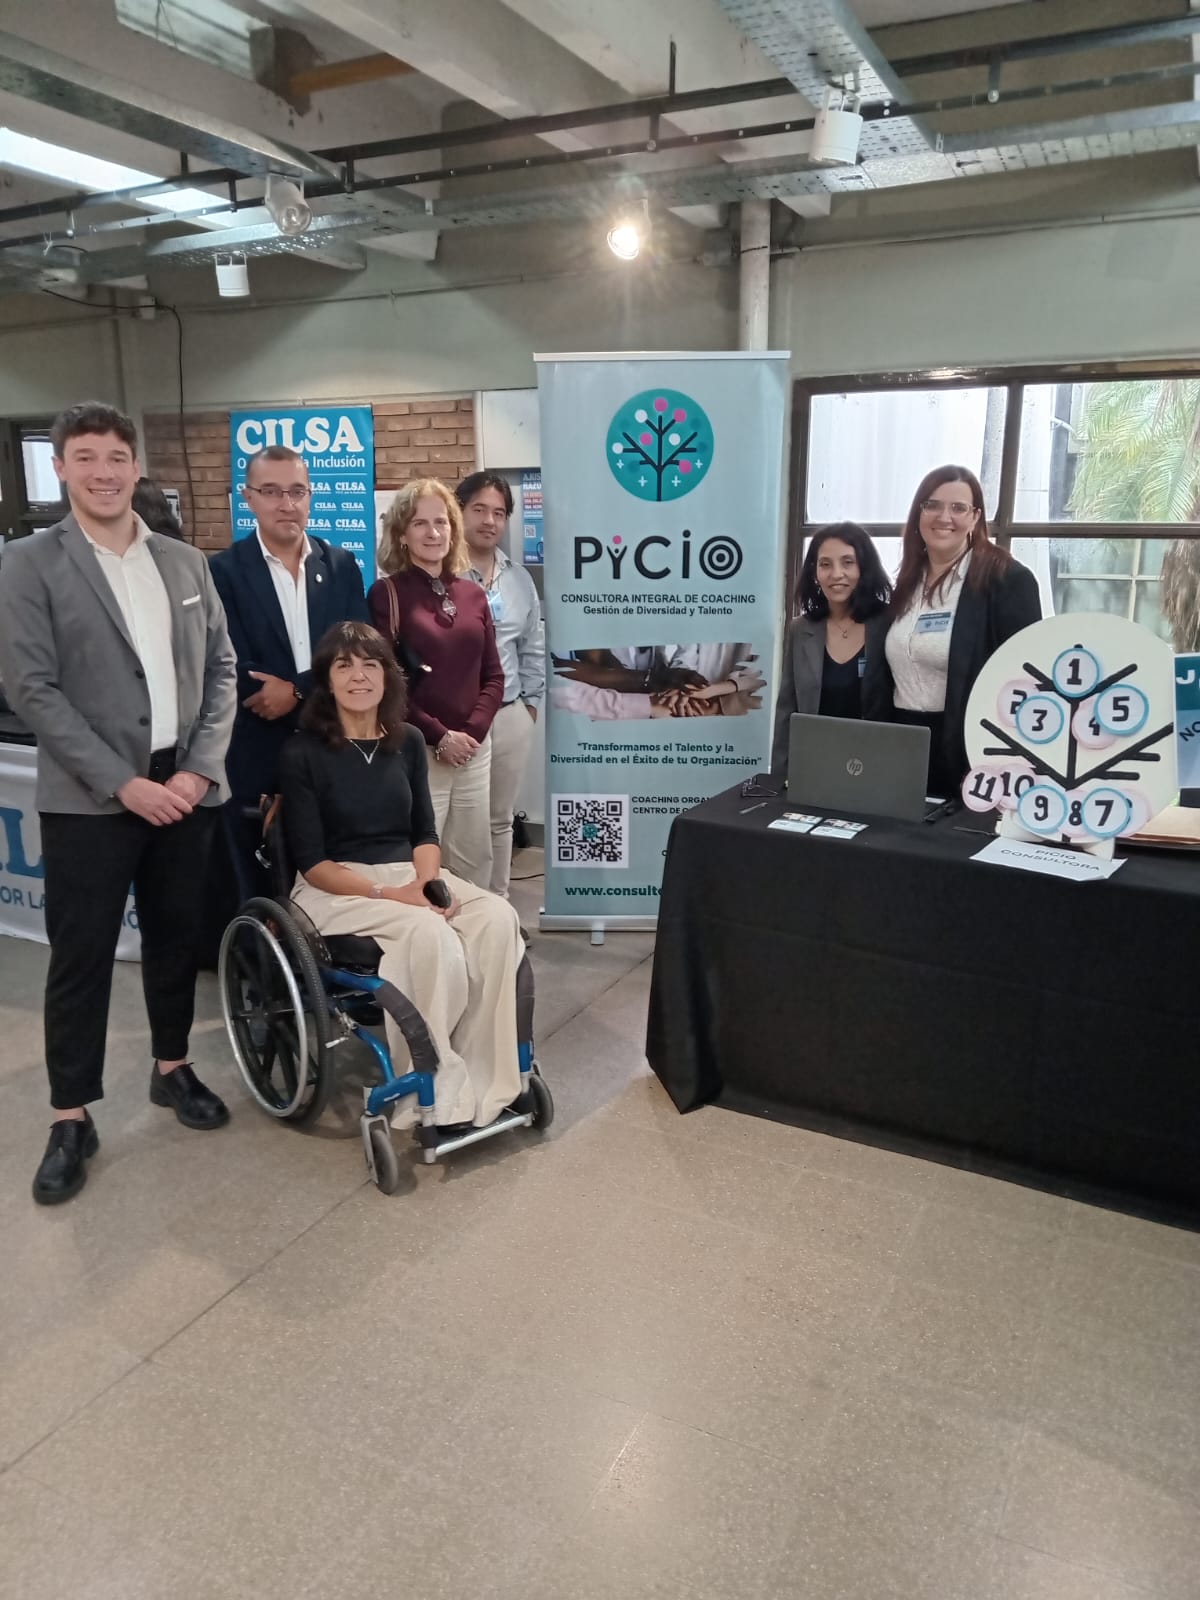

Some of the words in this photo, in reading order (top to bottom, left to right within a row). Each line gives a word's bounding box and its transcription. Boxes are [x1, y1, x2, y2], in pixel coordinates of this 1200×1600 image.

[237, 416, 364, 454] CILSA
[313, 455, 365, 468] Inclusión
[335, 482, 366, 490] CILSA
[237, 518, 257, 526] CILS
[307, 519, 331, 528] ILSA
[335, 519, 366, 528] CILSA
[561, 594, 629, 603] CONSULTORA
[632, 594, 682, 603] INTEGRAL
[685, 594, 698, 603] DE
[701, 594, 756, 603] COACHING
[583, 605, 620, 614] Gestión
[623, 606, 634, 615] de
[636, 606, 687, 615] Diversidad
[689, 608, 695, 617] y
[697, 606, 733, 615] Talento
[1066, 658, 1082, 685] 1
[1031, 709, 1048, 731] 3
[1112, 696, 1130, 722] 5
[550, 754, 603, 764] Diversidad
[605, 756, 618, 764] en
[620, 754, 630, 764] el
[633, 753, 659, 764] Éxito
[661, 755, 675, 765] de
[677, 756, 688, 765] tu
[663, 743, 673, 752] el
[675, 743, 713, 752] Talento
[715, 745, 722, 754] y
[725, 743, 734, 752] la
[969, 772, 998, 802] 11
[1000, 771, 1034, 797] 10
[632, 796, 679, 804] COACHING
[681, 796, 710, 804] ORGA
[1034, 795, 1049, 821] 9
[1069, 800, 1083, 826] 8
[1095, 800, 1114, 827] 7
[1000, 849, 1100, 871] CONSULTORA
[1035, 849, 1077, 860] PICIO
